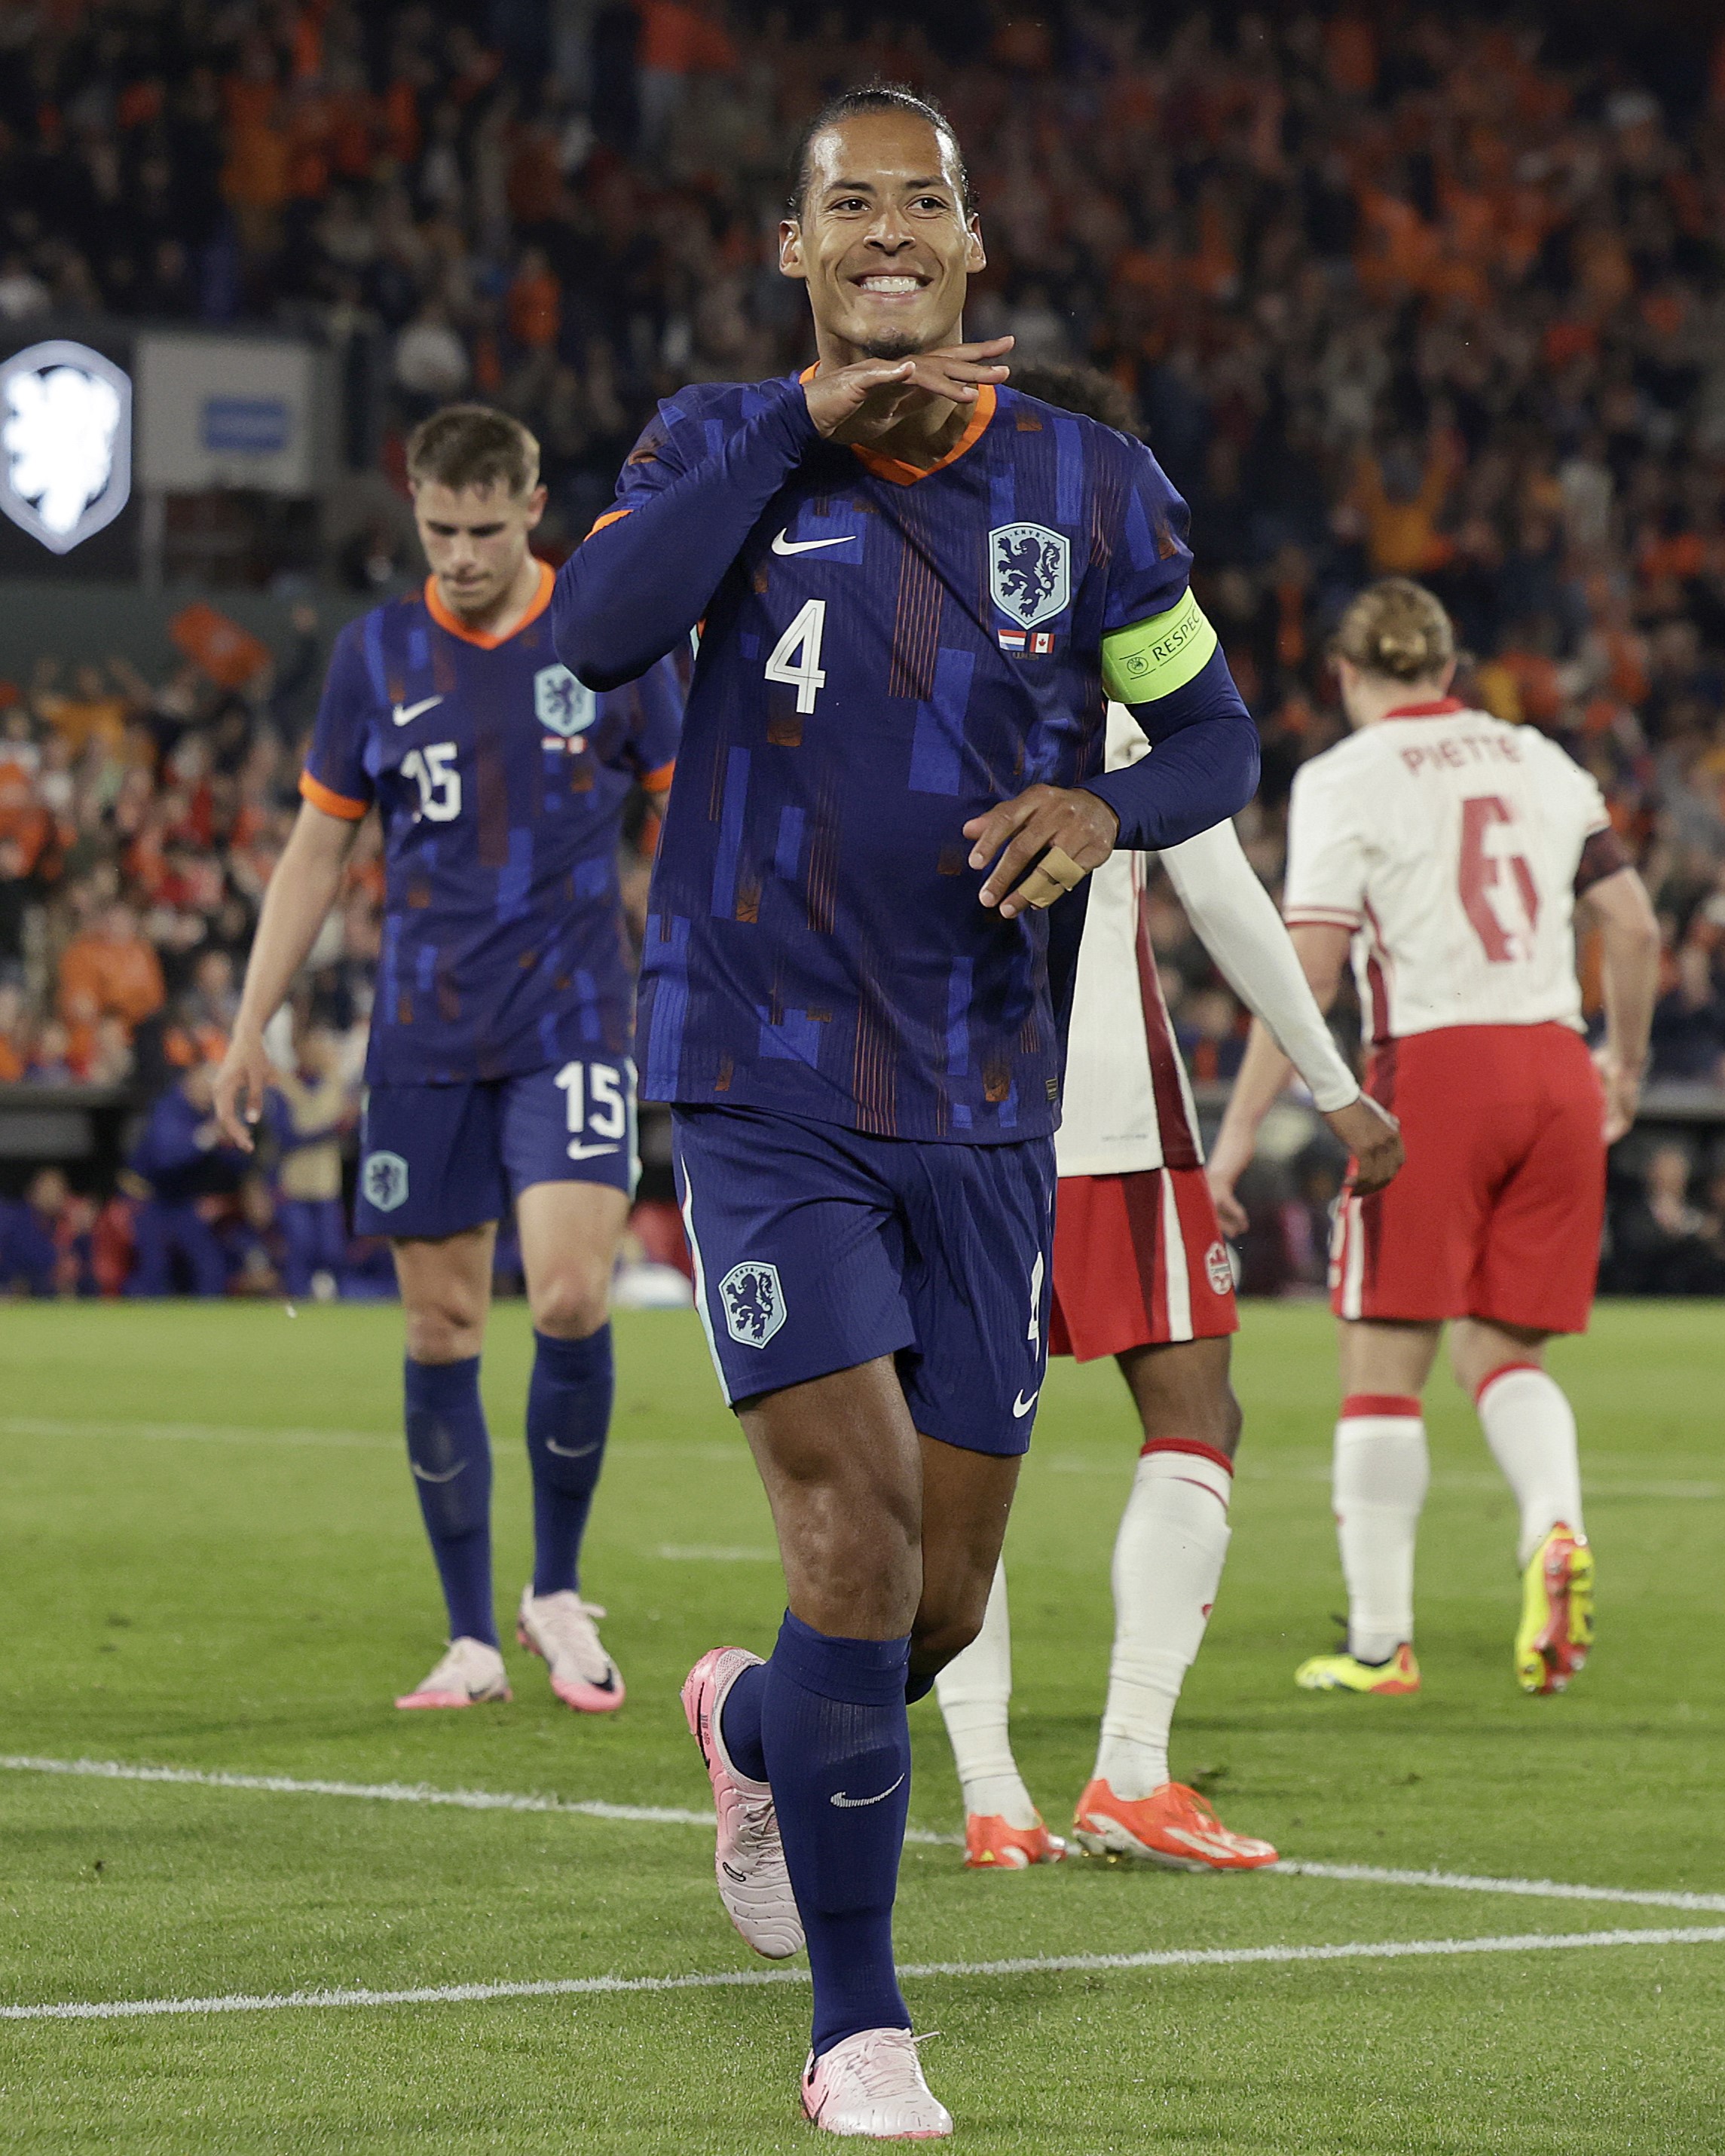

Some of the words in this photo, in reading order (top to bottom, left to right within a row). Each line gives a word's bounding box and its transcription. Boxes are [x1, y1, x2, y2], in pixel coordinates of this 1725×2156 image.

[764, 599, 826, 714] 4
[1152, 604, 1202, 662] RESPEC
[400, 742, 461, 821] 15
[1458, 797, 1538, 962] 6
[553, 1060, 625, 1139] 15
